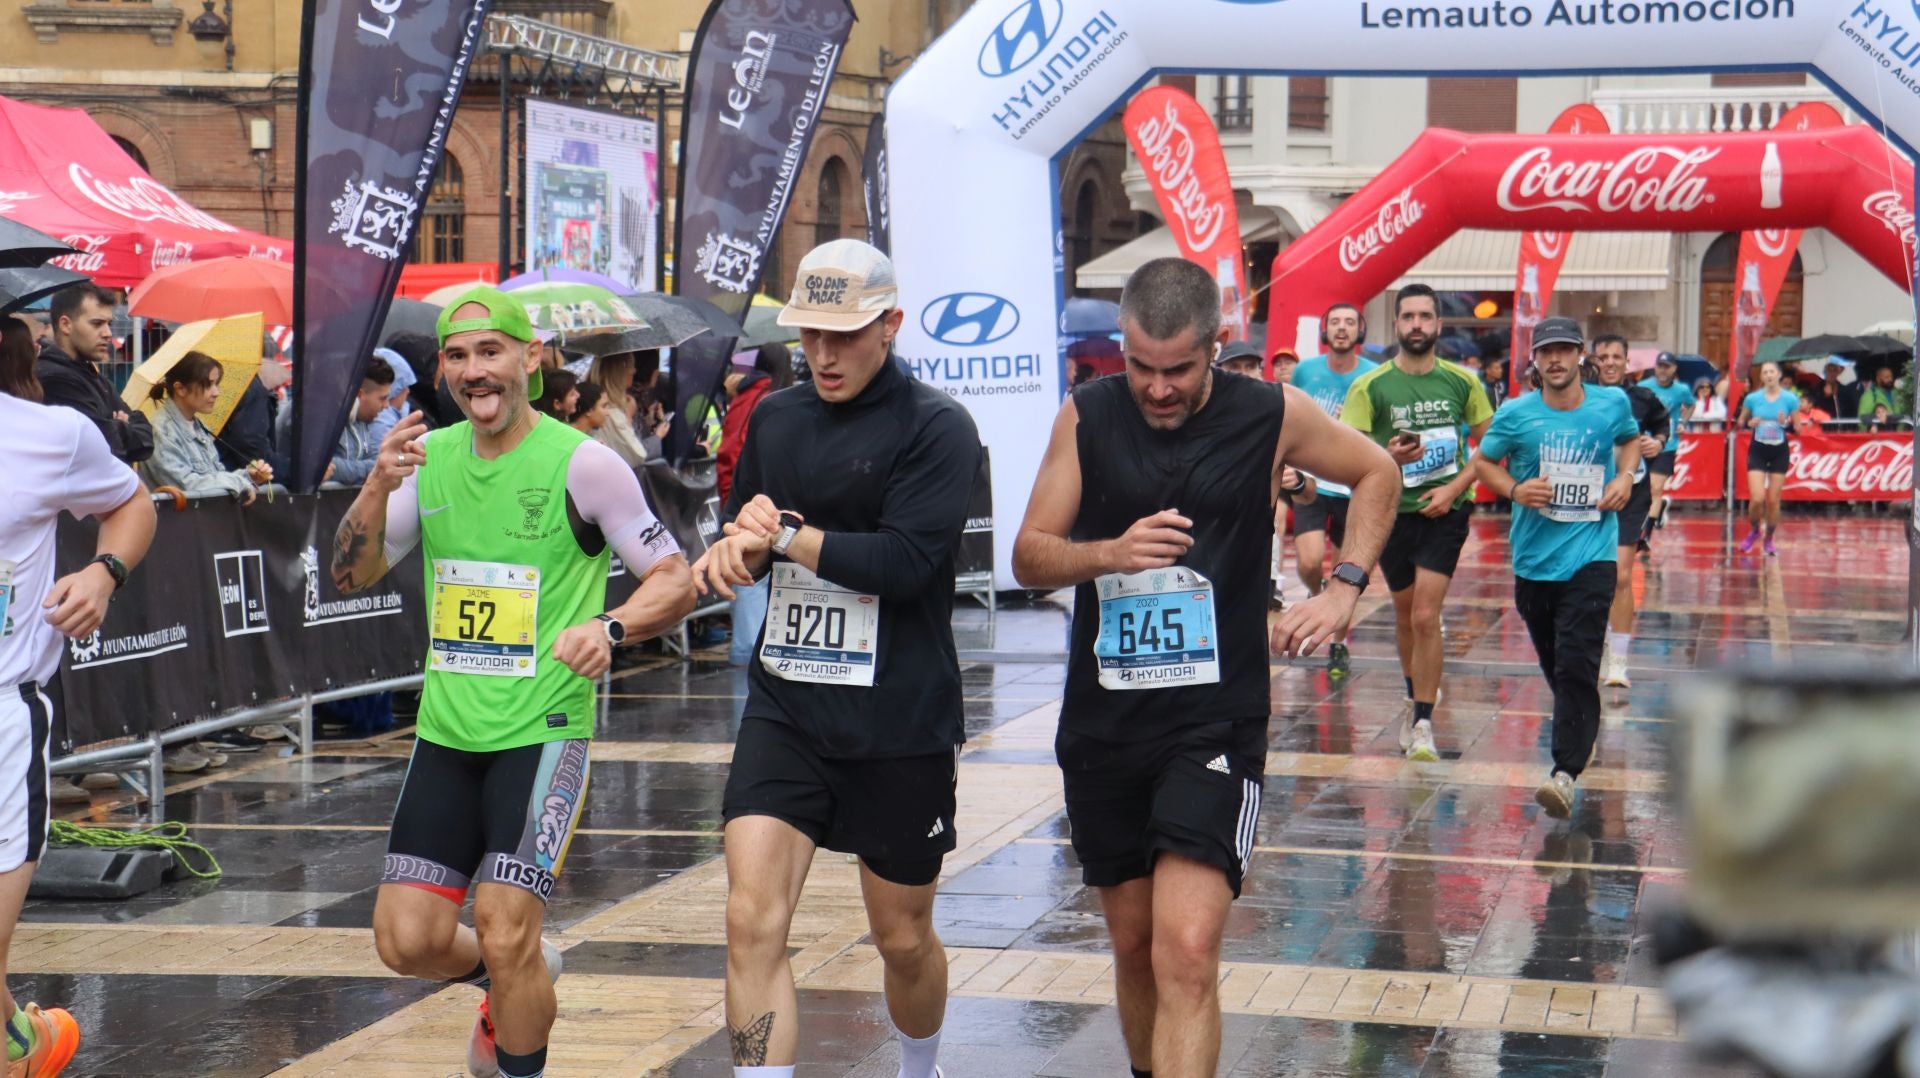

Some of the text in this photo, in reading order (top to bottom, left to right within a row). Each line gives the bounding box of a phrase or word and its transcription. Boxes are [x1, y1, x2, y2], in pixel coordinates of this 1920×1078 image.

[1361, 1, 1533, 28] Lemauto
[992, 10, 1117, 131] HYUNDAI
[1838, 20, 1920, 98] Lemauto Auto
[1011, 31, 1128, 140] Lemauto Automoción
[757, 41, 834, 244] AYUNTAMIENTO DE LEÓN
[1496, 146, 1722, 212] Coca-Cola
[69, 163, 240, 232] Coca-Cola
[1338, 185, 1424, 272] Coca-Cola
[806, 275, 849, 289] GO ONE
[808, 290, 846, 305] MORE
[962, 382, 1041, 396] Automoción
[1414, 400, 1450, 412] aecc
[1553, 483, 1590, 505] 1198
[319, 590, 402, 617] AYUNTAMIENTO DE LEÓN
[802, 592, 829, 603] DIEGO
[458, 599, 496, 642] 52
[785, 603, 846, 649] 920
[1118, 607, 1185, 655] 645
[102, 632, 161, 656] AYUNTAMIENT
[169, 622, 187, 642] LEÓN
[460, 656, 514, 668] HYUNDAI
[794, 662, 852, 676] HYUNDAI
[1136, 665, 1197, 680] HYUNDAI
[1206, 763, 1231, 775] adidas
[493, 853, 556, 902] insta
